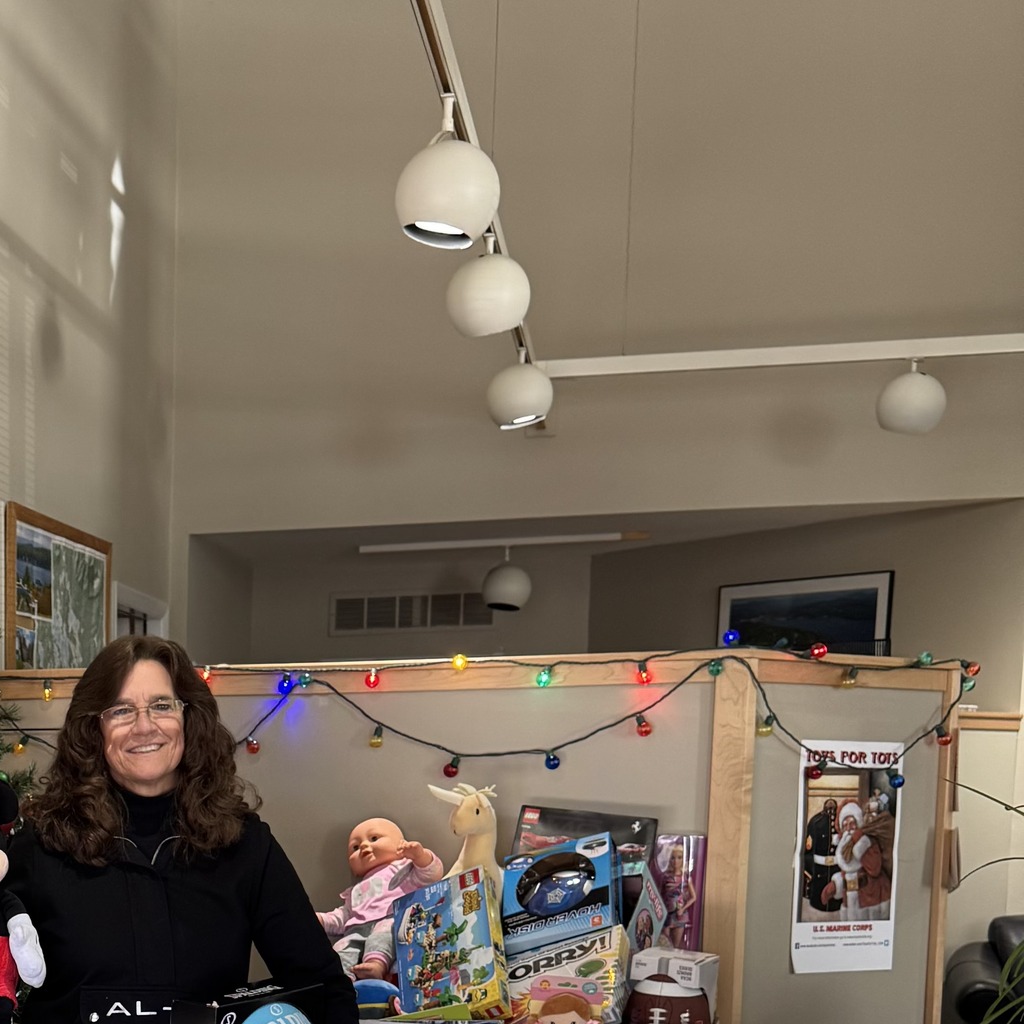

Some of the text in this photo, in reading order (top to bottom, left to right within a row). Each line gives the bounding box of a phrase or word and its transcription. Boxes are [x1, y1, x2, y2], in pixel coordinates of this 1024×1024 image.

[840, 751, 867, 764] FOR
[871, 751, 899, 765] TOTS
[523, 811, 539, 820] LEGO
[546, 903, 602, 926] HOVER
[508, 935, 608, 980] ORRY!
